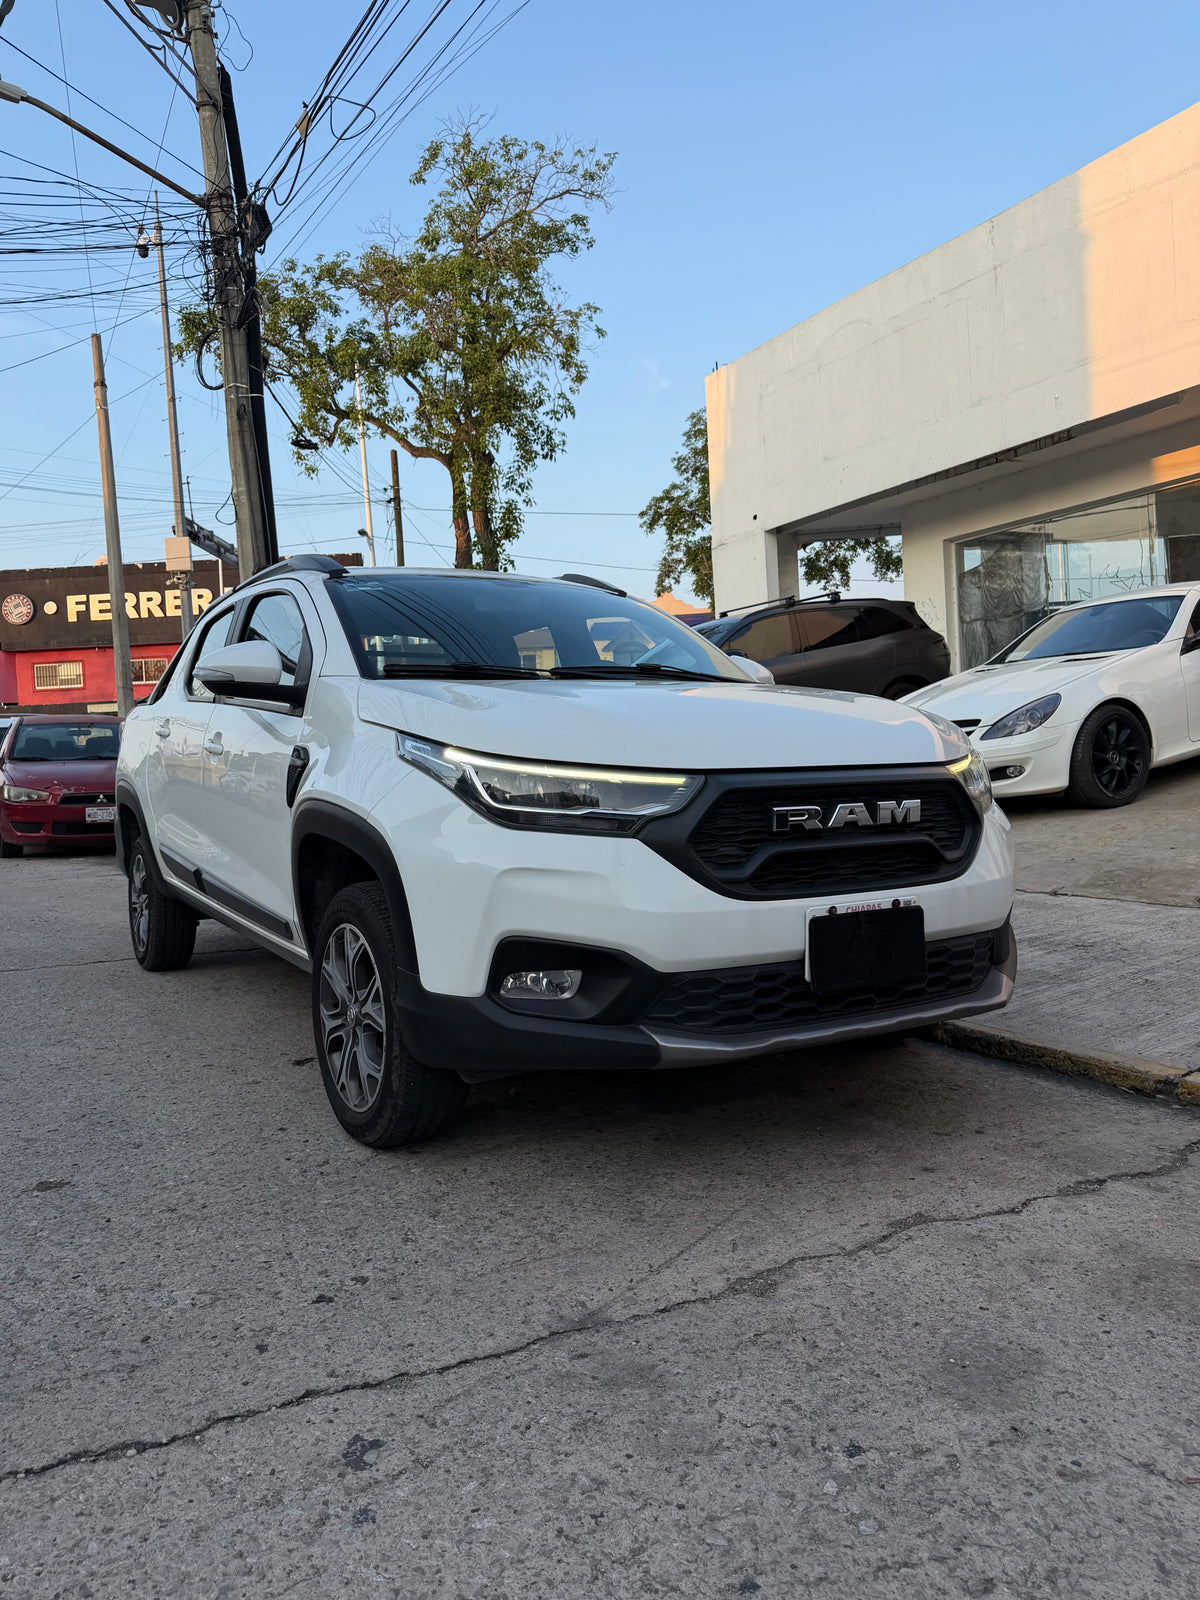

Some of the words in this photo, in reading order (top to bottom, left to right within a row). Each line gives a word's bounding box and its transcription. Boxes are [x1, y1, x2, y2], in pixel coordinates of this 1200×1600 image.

[66, 587, 233, 623] FERRER
[772, 799, 921, 832] RAM
[846, 903, 882, 913] CHIAPAS
